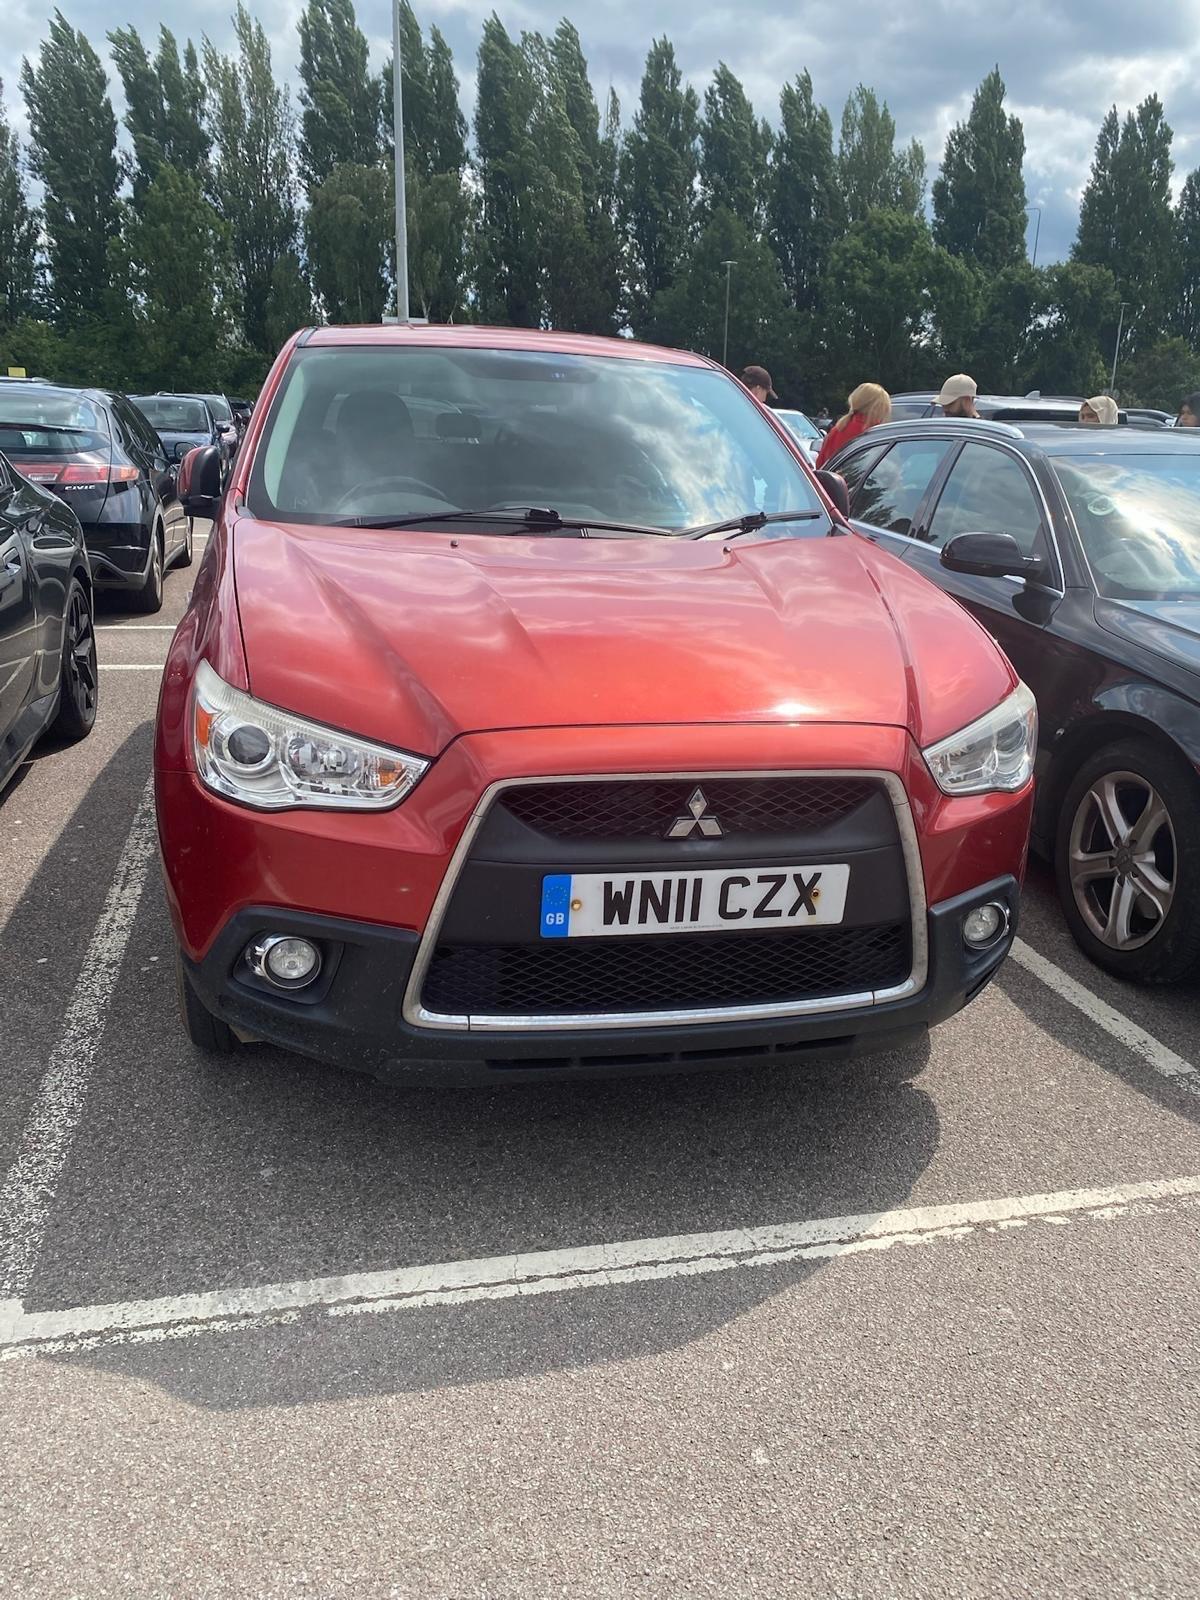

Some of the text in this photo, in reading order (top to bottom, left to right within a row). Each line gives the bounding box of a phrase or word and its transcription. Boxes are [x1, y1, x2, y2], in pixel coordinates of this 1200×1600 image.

[603, 872, 822, 925] WN11 CZX
[545, 912, 565, 925] GB
